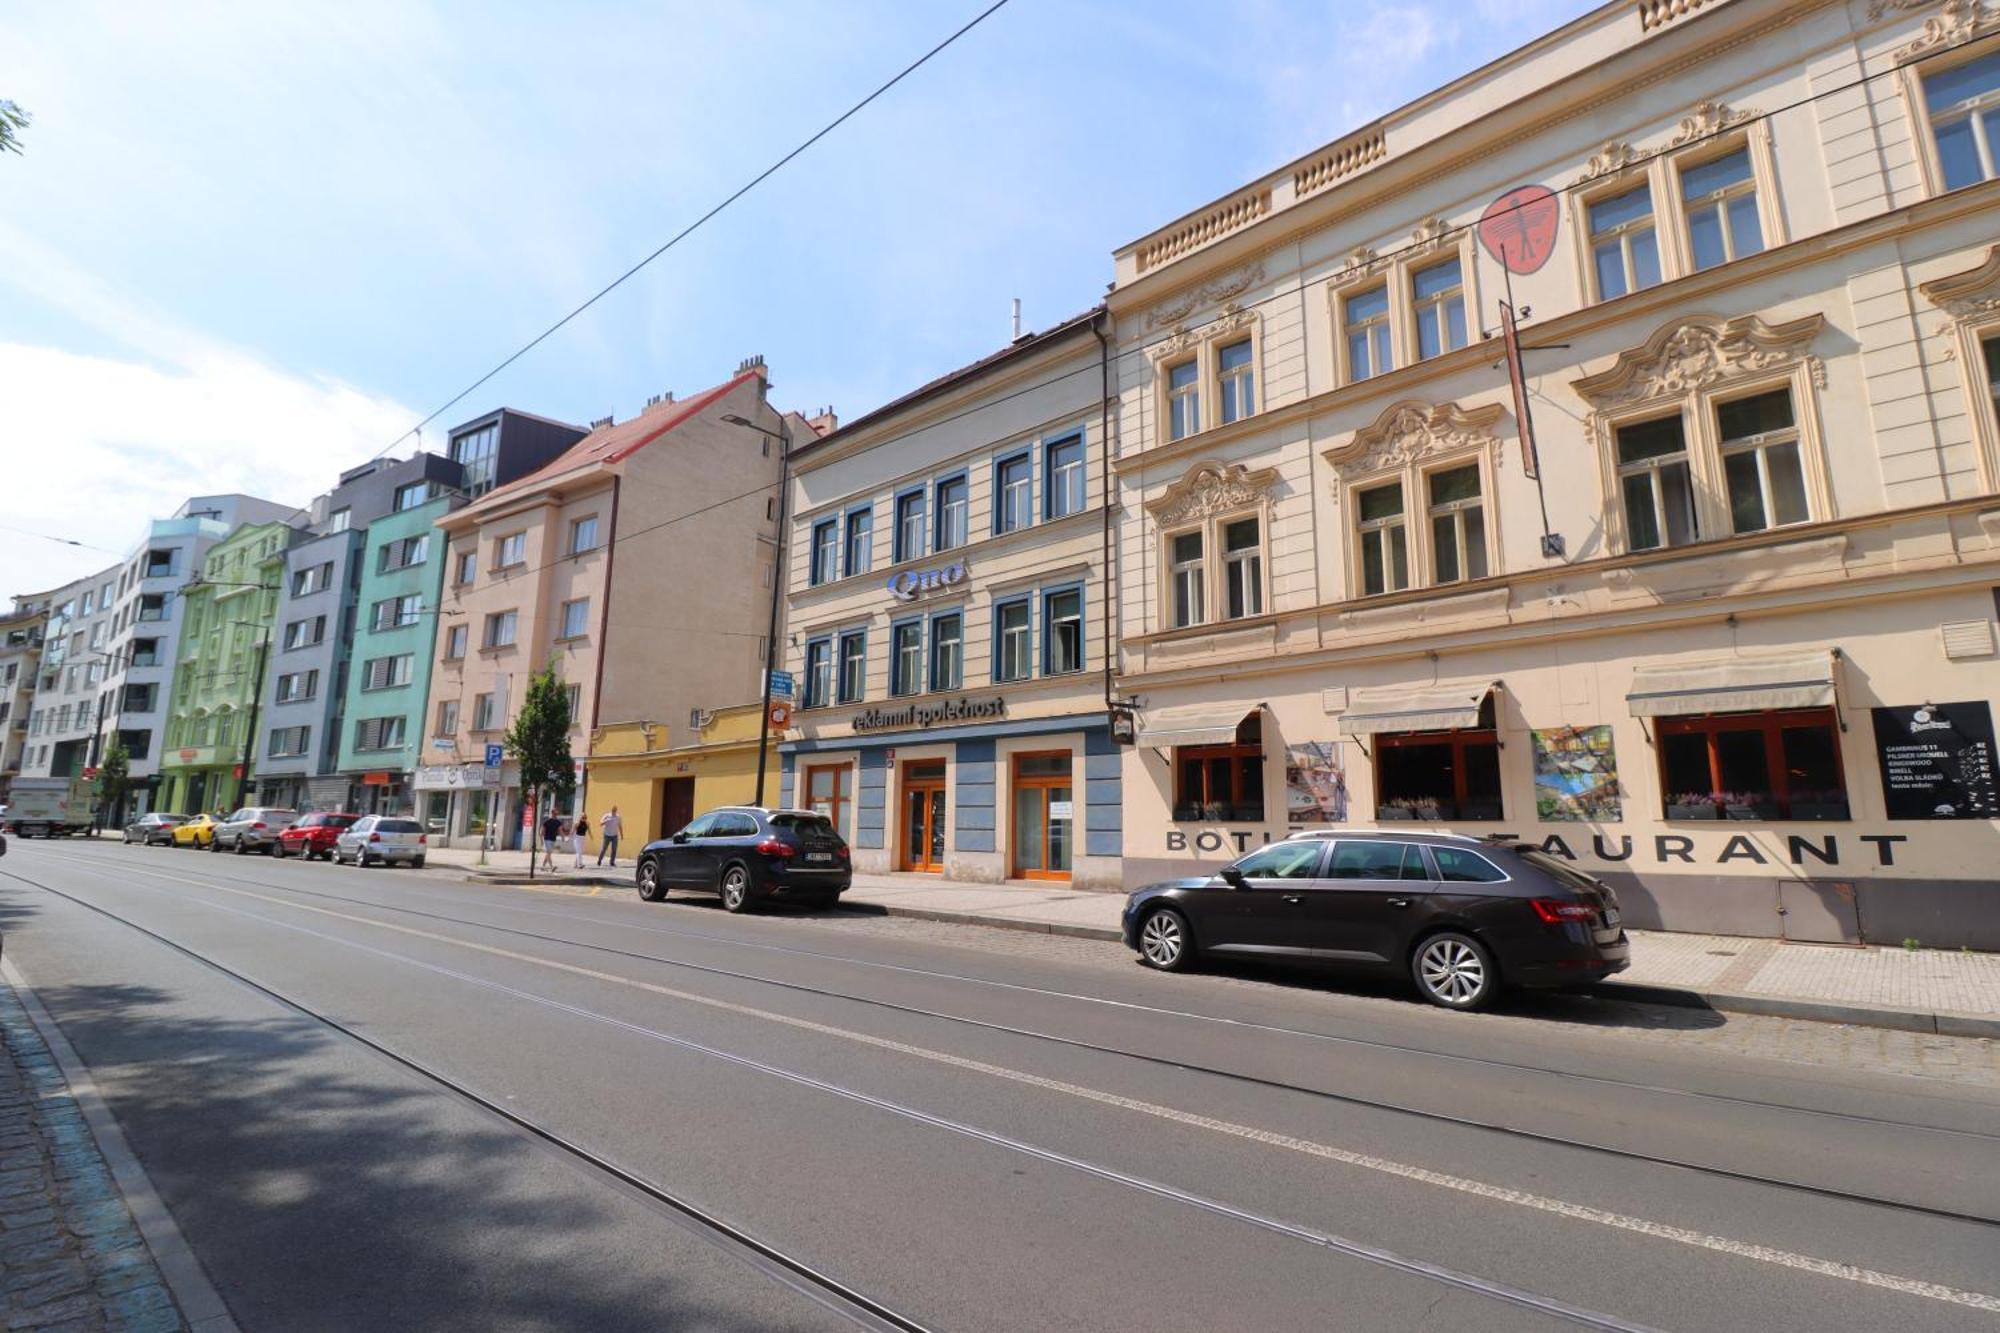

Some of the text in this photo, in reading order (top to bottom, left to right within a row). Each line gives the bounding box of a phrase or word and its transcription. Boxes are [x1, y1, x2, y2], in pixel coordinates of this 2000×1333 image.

[853, 697, 1004, 730] reklamní společnost
[1167, 827, 1303, 853] BOTI
